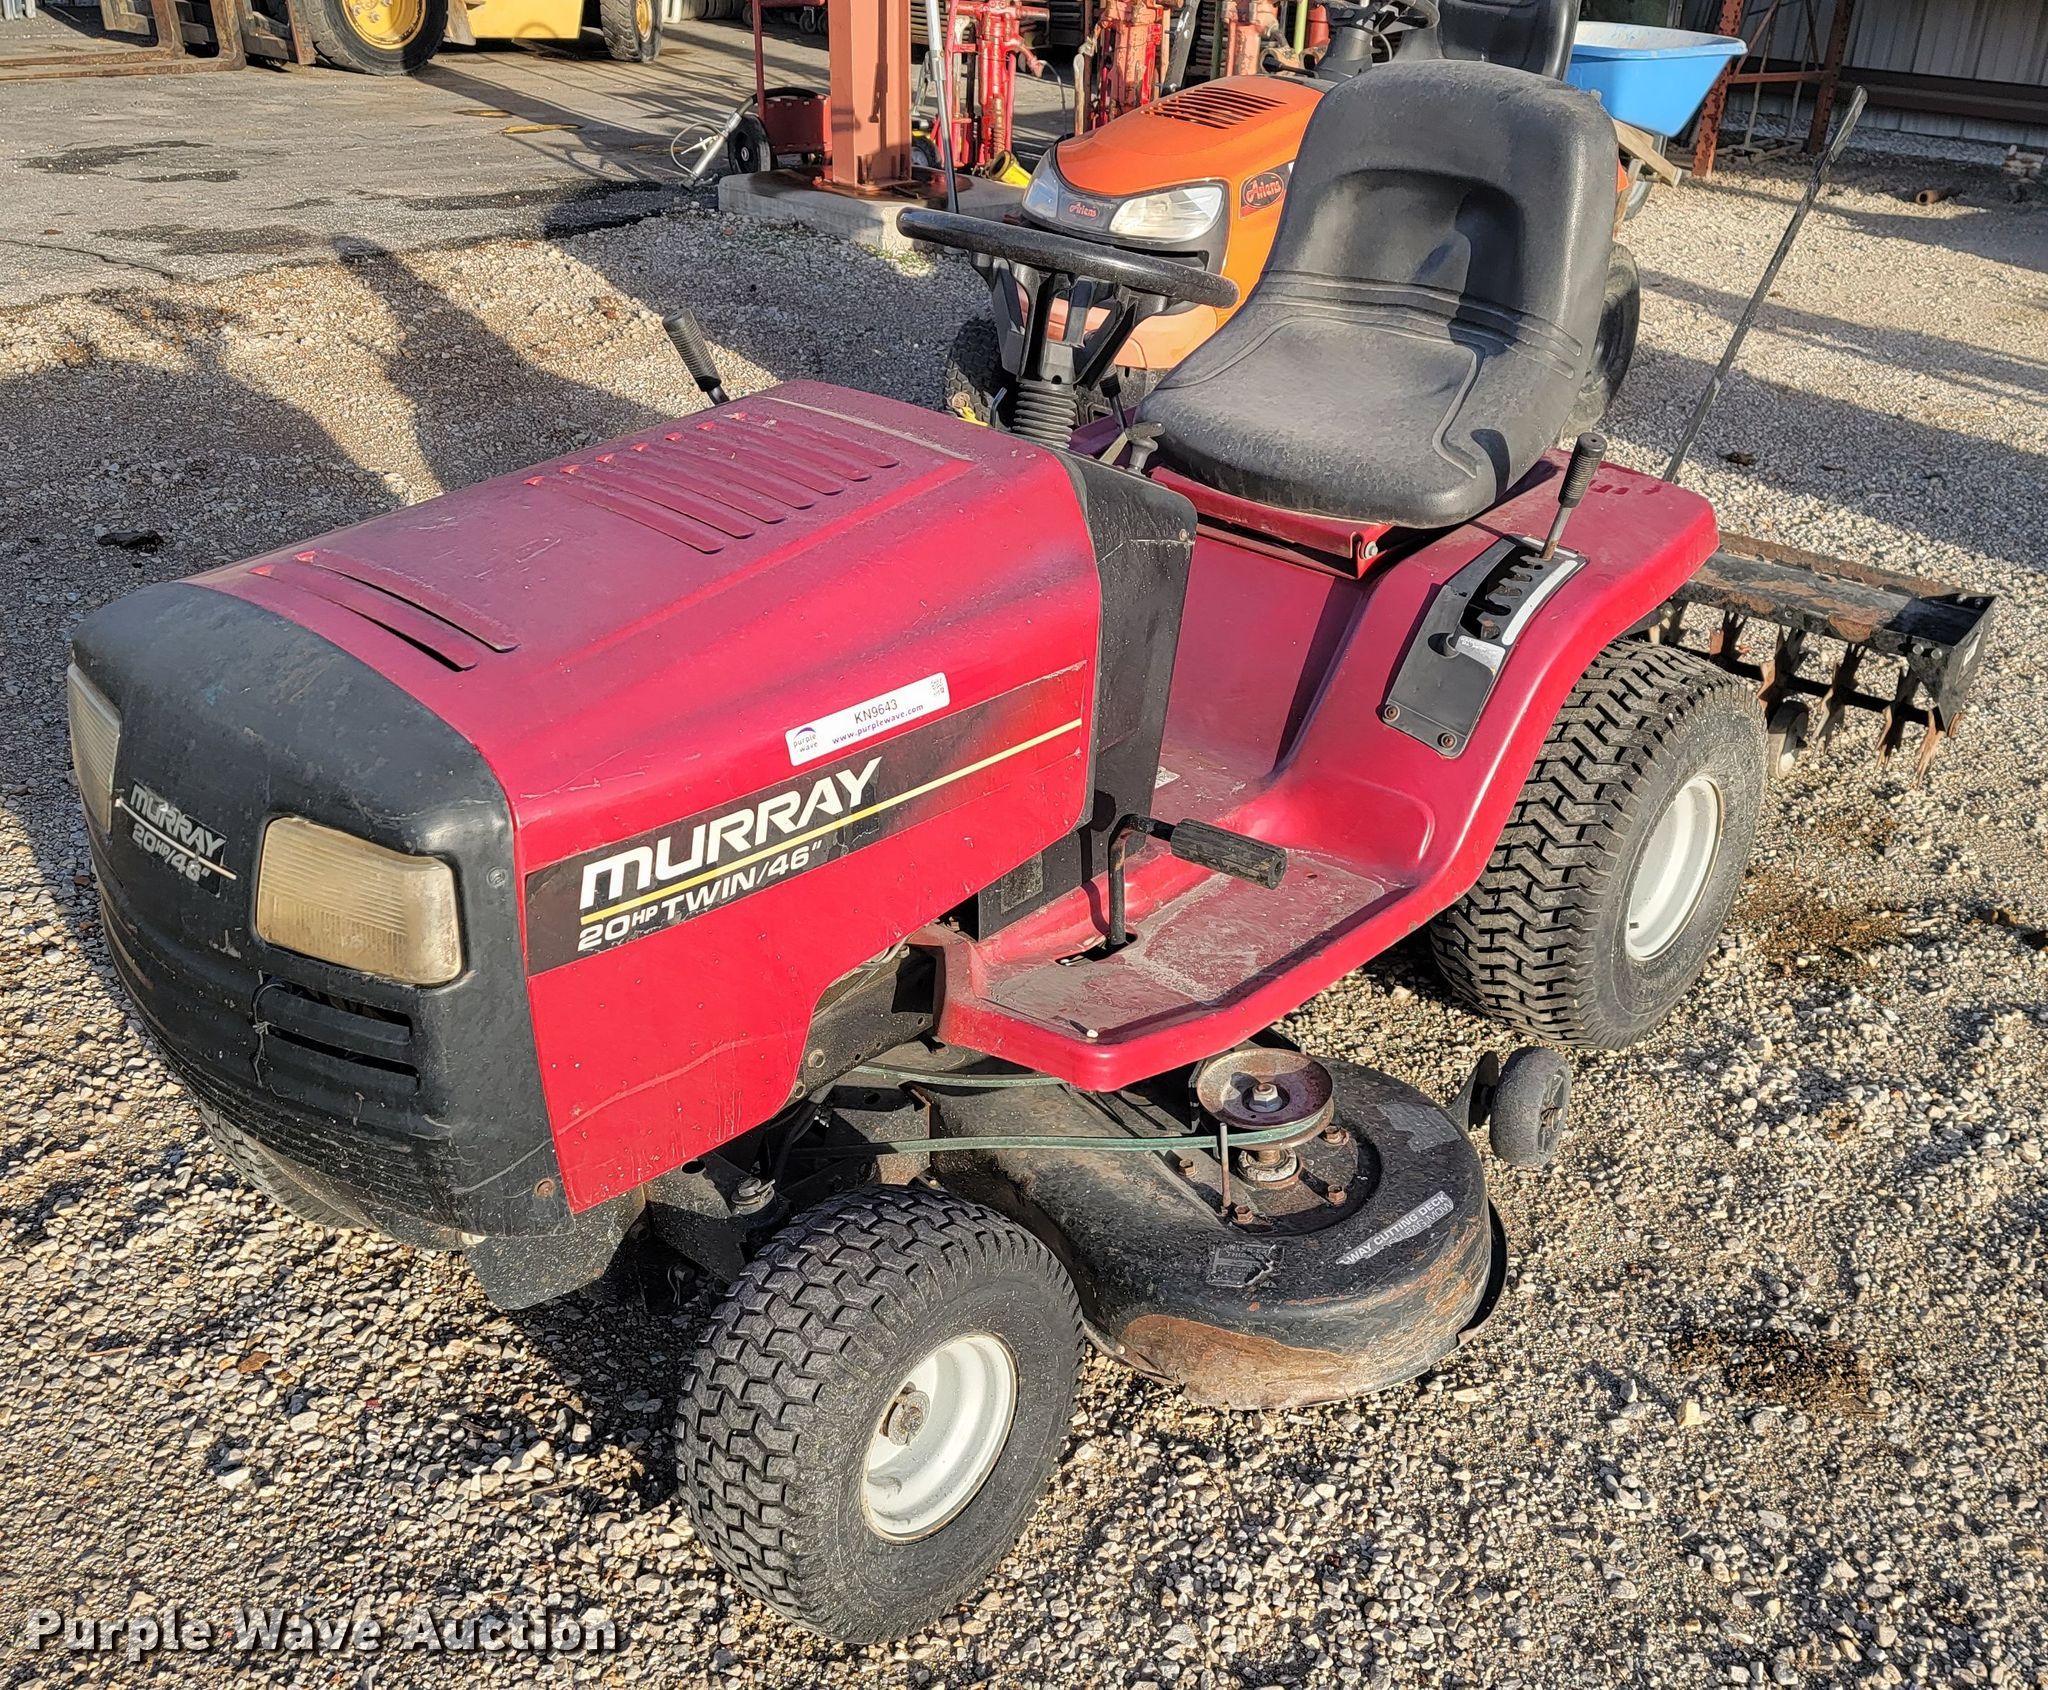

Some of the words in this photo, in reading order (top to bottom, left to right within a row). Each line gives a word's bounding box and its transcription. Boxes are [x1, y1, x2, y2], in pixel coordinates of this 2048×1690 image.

[832, 704, 924, 745] www.purplewave.com
[854, 699, 898, 724] KN9643
[793, 734, 817, 748] purple
[799, 741, 819, 753] wave
[130, 784, 227, 858] MURRAY
[579, 756, 882, 910] MURRAY
[1373, 1213, 1419, 1246] CUTTING
[1419, 1193, 1448, 1217] DECK
